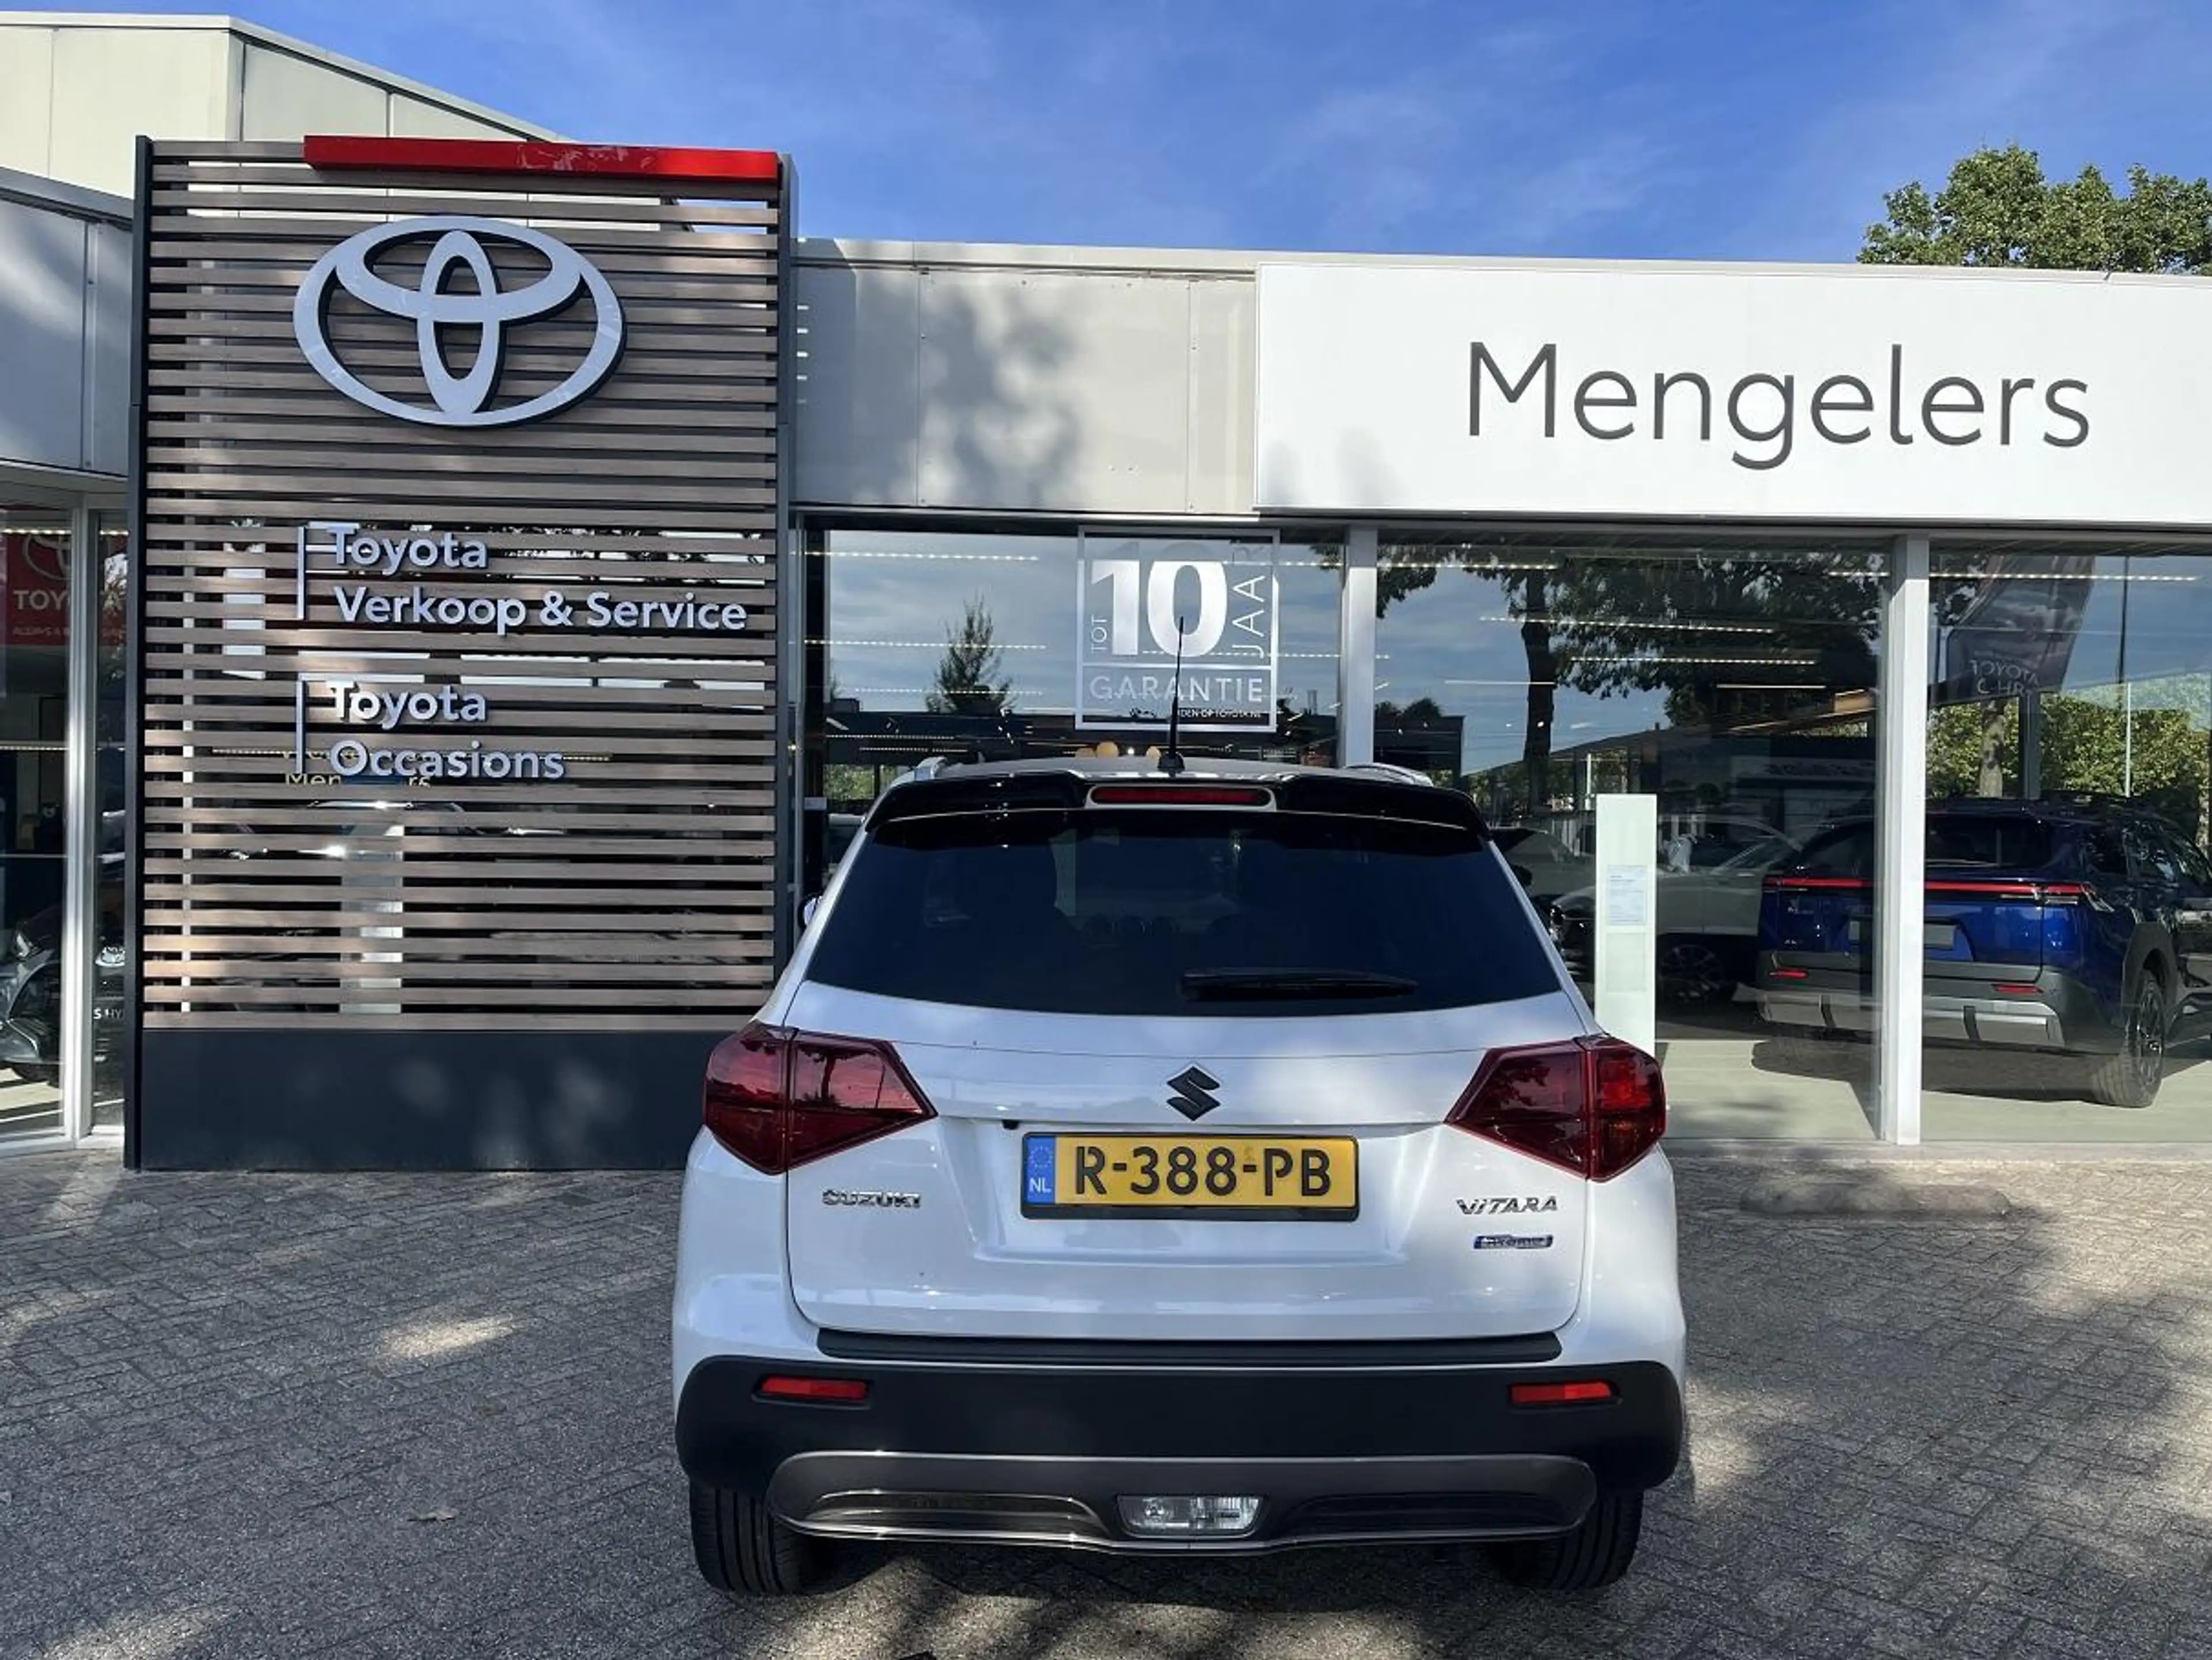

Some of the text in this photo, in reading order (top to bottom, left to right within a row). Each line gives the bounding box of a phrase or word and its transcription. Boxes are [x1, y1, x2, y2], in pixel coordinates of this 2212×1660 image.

[1469, 341, 2090, 470] Mengelers
[327, 526, 488, 575] Toyota
[334, 586, 747, 635] Verkoop & Service
[1091, 542, 1227, 657] 10
[1091, 615, 1107, 654] TOT
[1089, 676, 1263, 703] GARANTIE
[1969, 659, 2039, 686] TOYOTA
[327, 681, 487, 729] Toyota
[330, 740, 565, 780] Occasions
[1029, 1178, 1052, 1194] NL
[1076, 1146, 1331, 1197] R-388-PB
[822, 1190, 921, 1209] SUZUKI
[1456, 1196, 1558, 1214] VITARA
